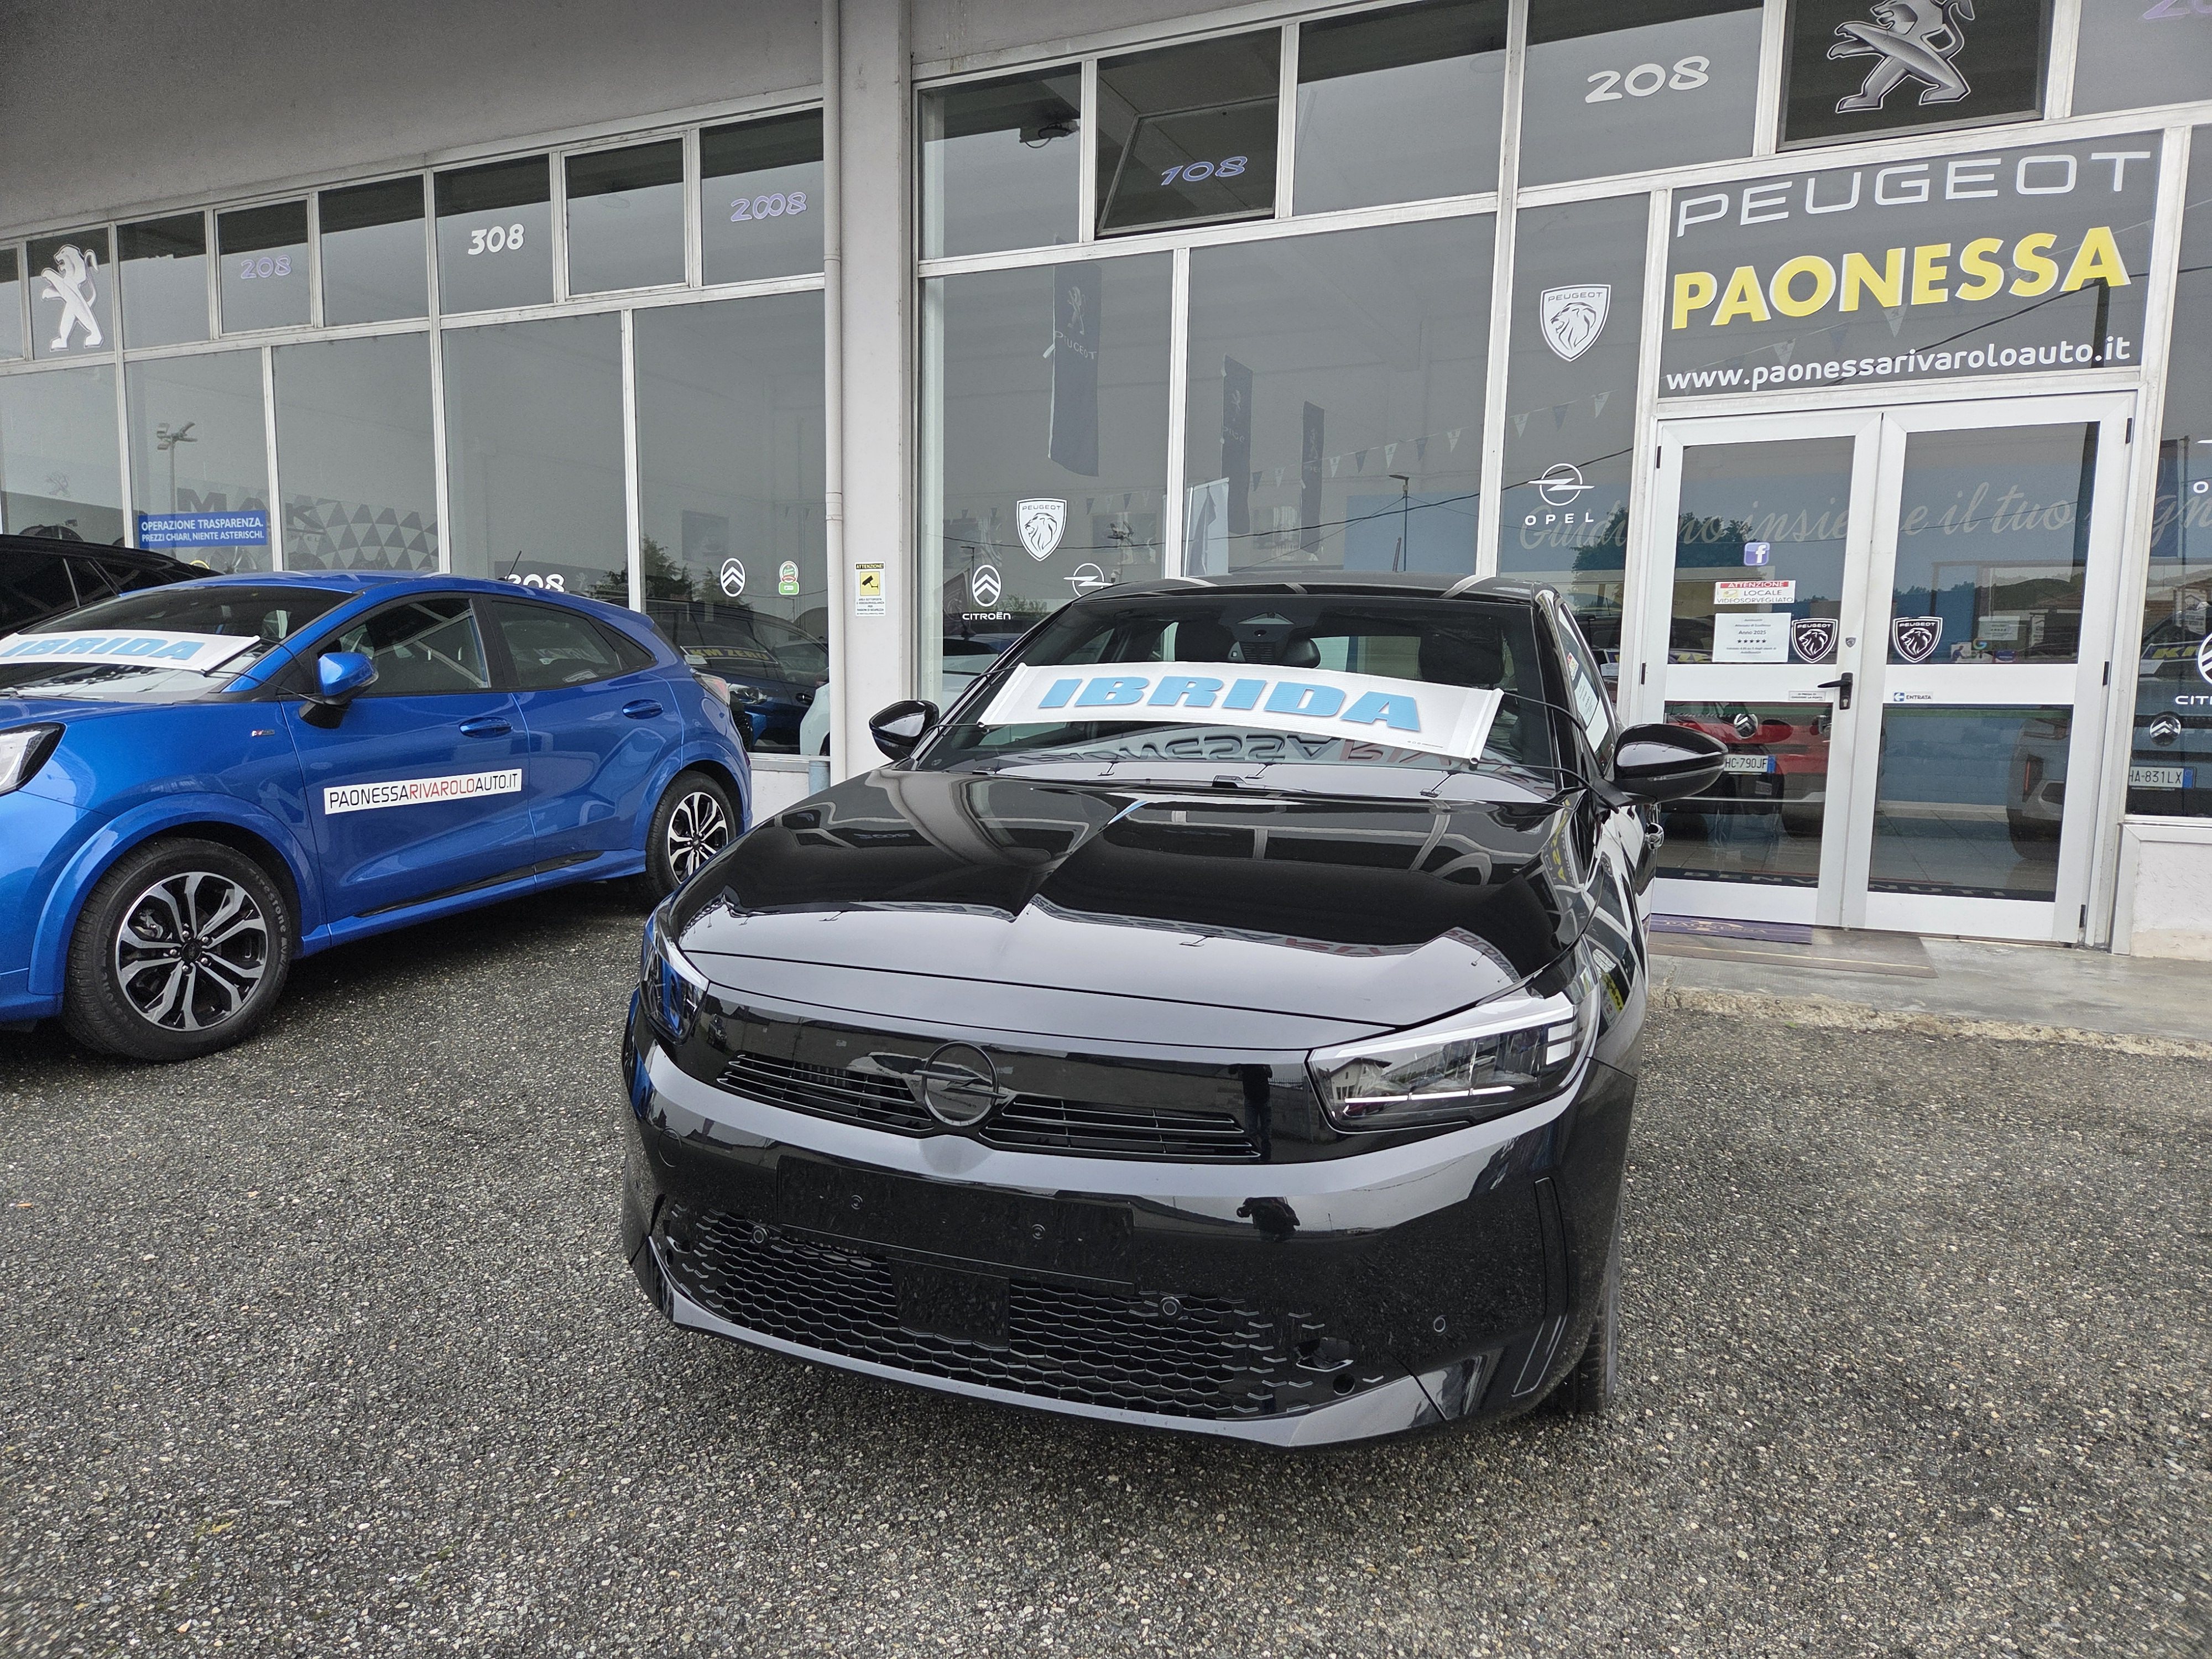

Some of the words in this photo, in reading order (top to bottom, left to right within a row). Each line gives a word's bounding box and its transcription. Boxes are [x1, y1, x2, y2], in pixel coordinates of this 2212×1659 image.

[1585, 56, 1709, 103] 208
[1161, 155, 1248, 185] 108
[731, 192, 807, 222] 2008
[1677, 150, 2151, 237] PEUGEOT
[468, 224, 524, 255] 308
[241, 255, 292, 279] 208
[1672, 226, 2131, 329] PAONESSA
[1548, 292, 1603, 302] PEUGEOT
[1667, 336, 2130, 390] www.paonessarivaroloauto.it
[142, 520, 195, 531] OPERAZIONE
[197, 517, 263, 529] TRASPARENZA.
[1525, 512, 1594, 526] OPEL
[142, 533, 165, 541] PREZZI
[166, 533, 192, 542] CHIARI,
[192, 531, 219, 540] NIENTE
[220, 530, 264, 540] ASTERISCHI.
[1, 637, 205, 660] IBRIDA
[1038, 675, 1421, 732] IBRIDA
[330, 773, 518, 809] PAONESSARIVAROLOAUTO.IT
